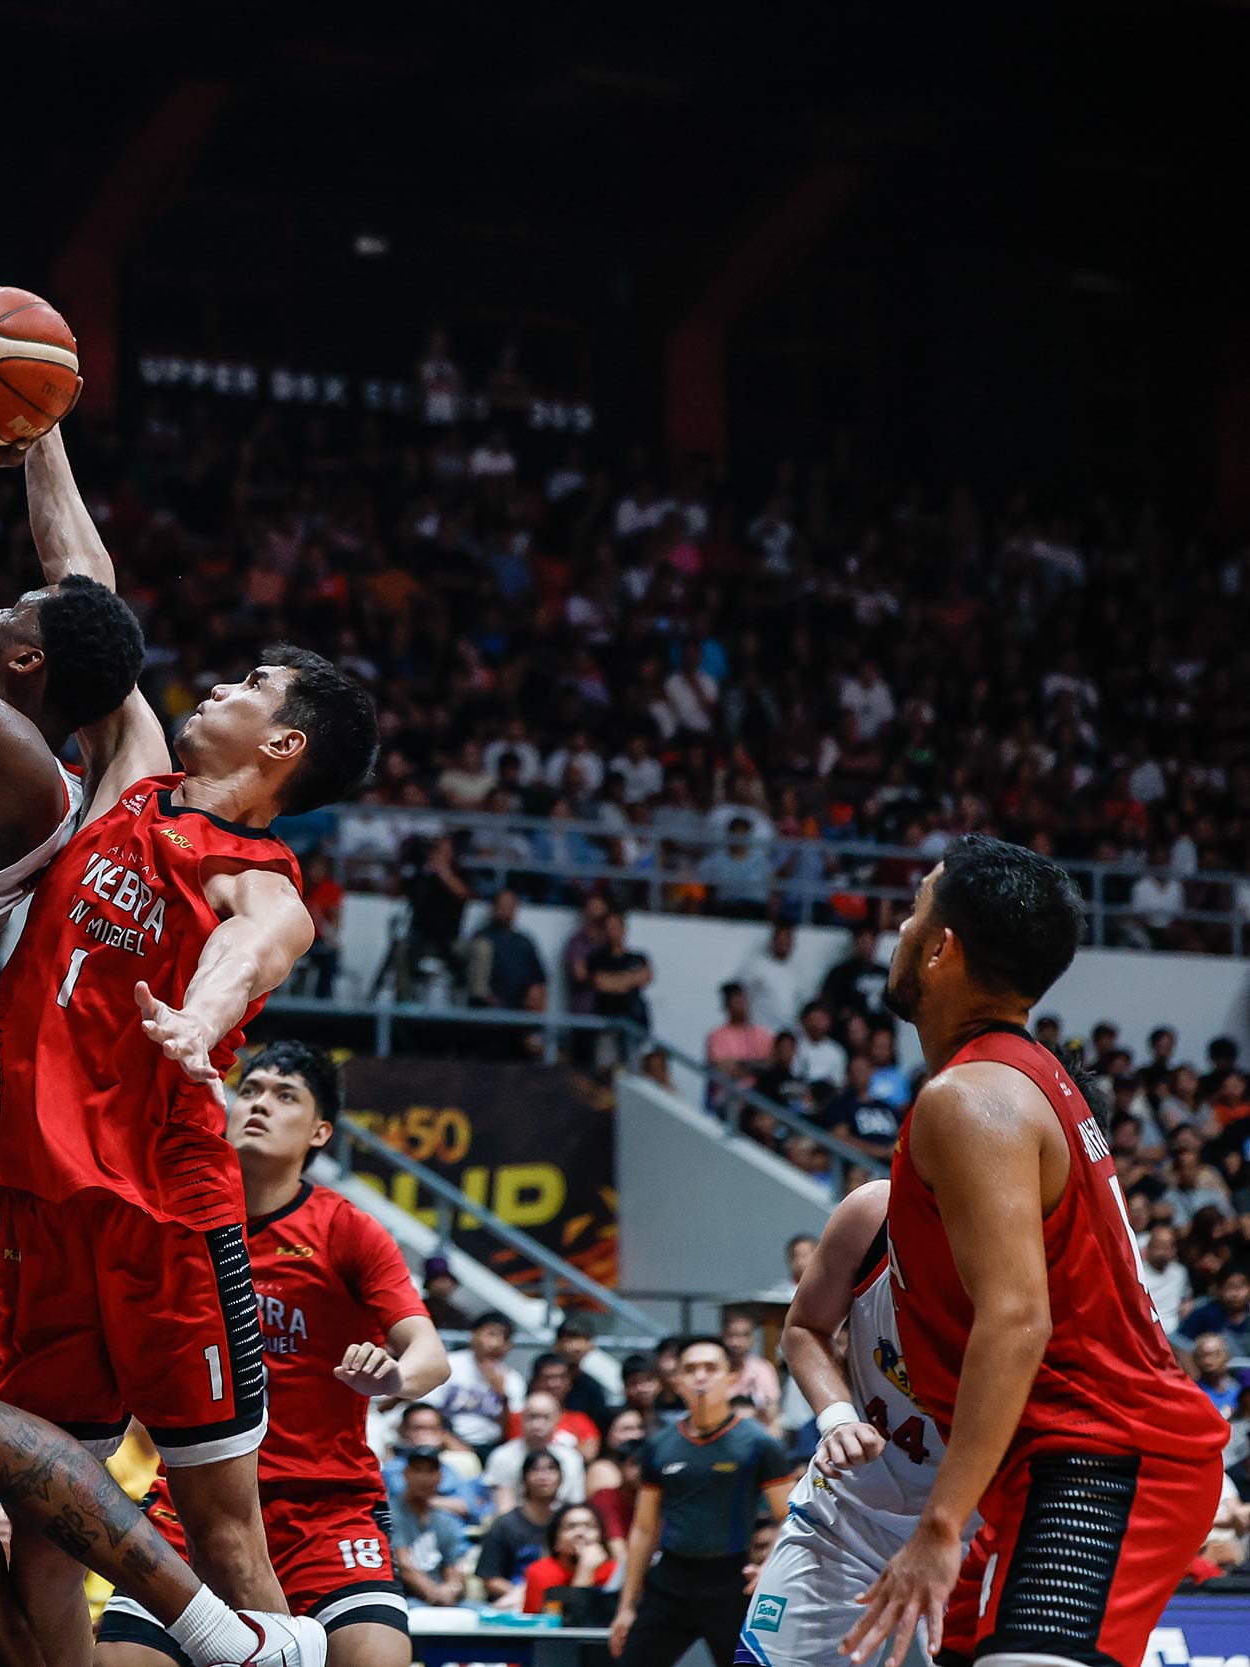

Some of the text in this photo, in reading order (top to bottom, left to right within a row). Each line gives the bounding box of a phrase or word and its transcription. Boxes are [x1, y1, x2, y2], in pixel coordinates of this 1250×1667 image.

[56, 948, 89, 1008] 1
[204, 1345, 223, 1401] 1
[865, 1396, 930, 1465] 44
[338, 1538, 384, 1569] 18
